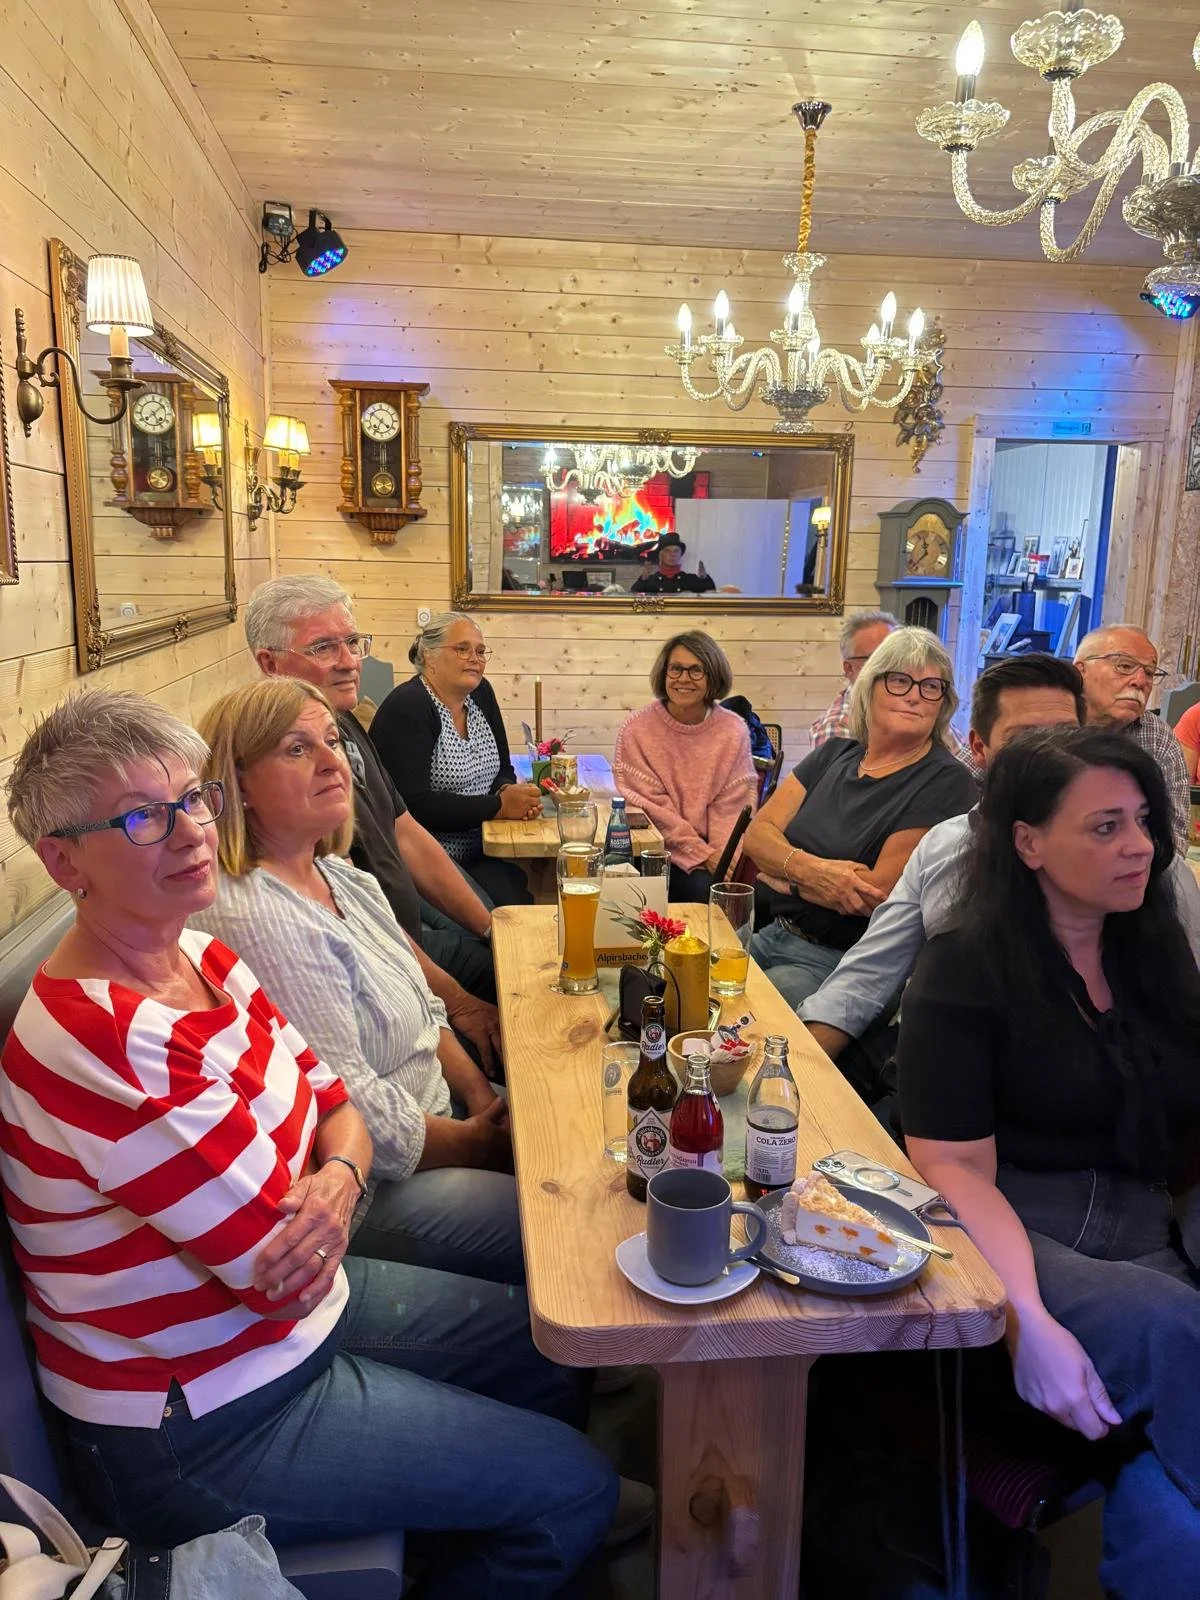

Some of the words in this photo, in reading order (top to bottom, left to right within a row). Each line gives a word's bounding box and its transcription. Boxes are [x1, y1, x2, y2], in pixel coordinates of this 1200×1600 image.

[597, 952, 648, 963] Alpirsbache
[641, 1041, 665, 1052] Radler
[756, 1136, 777, 1146] COLA
[778, 1136, 796, 1146] ZERO
[636, 1154, 664, 1167] Radler
